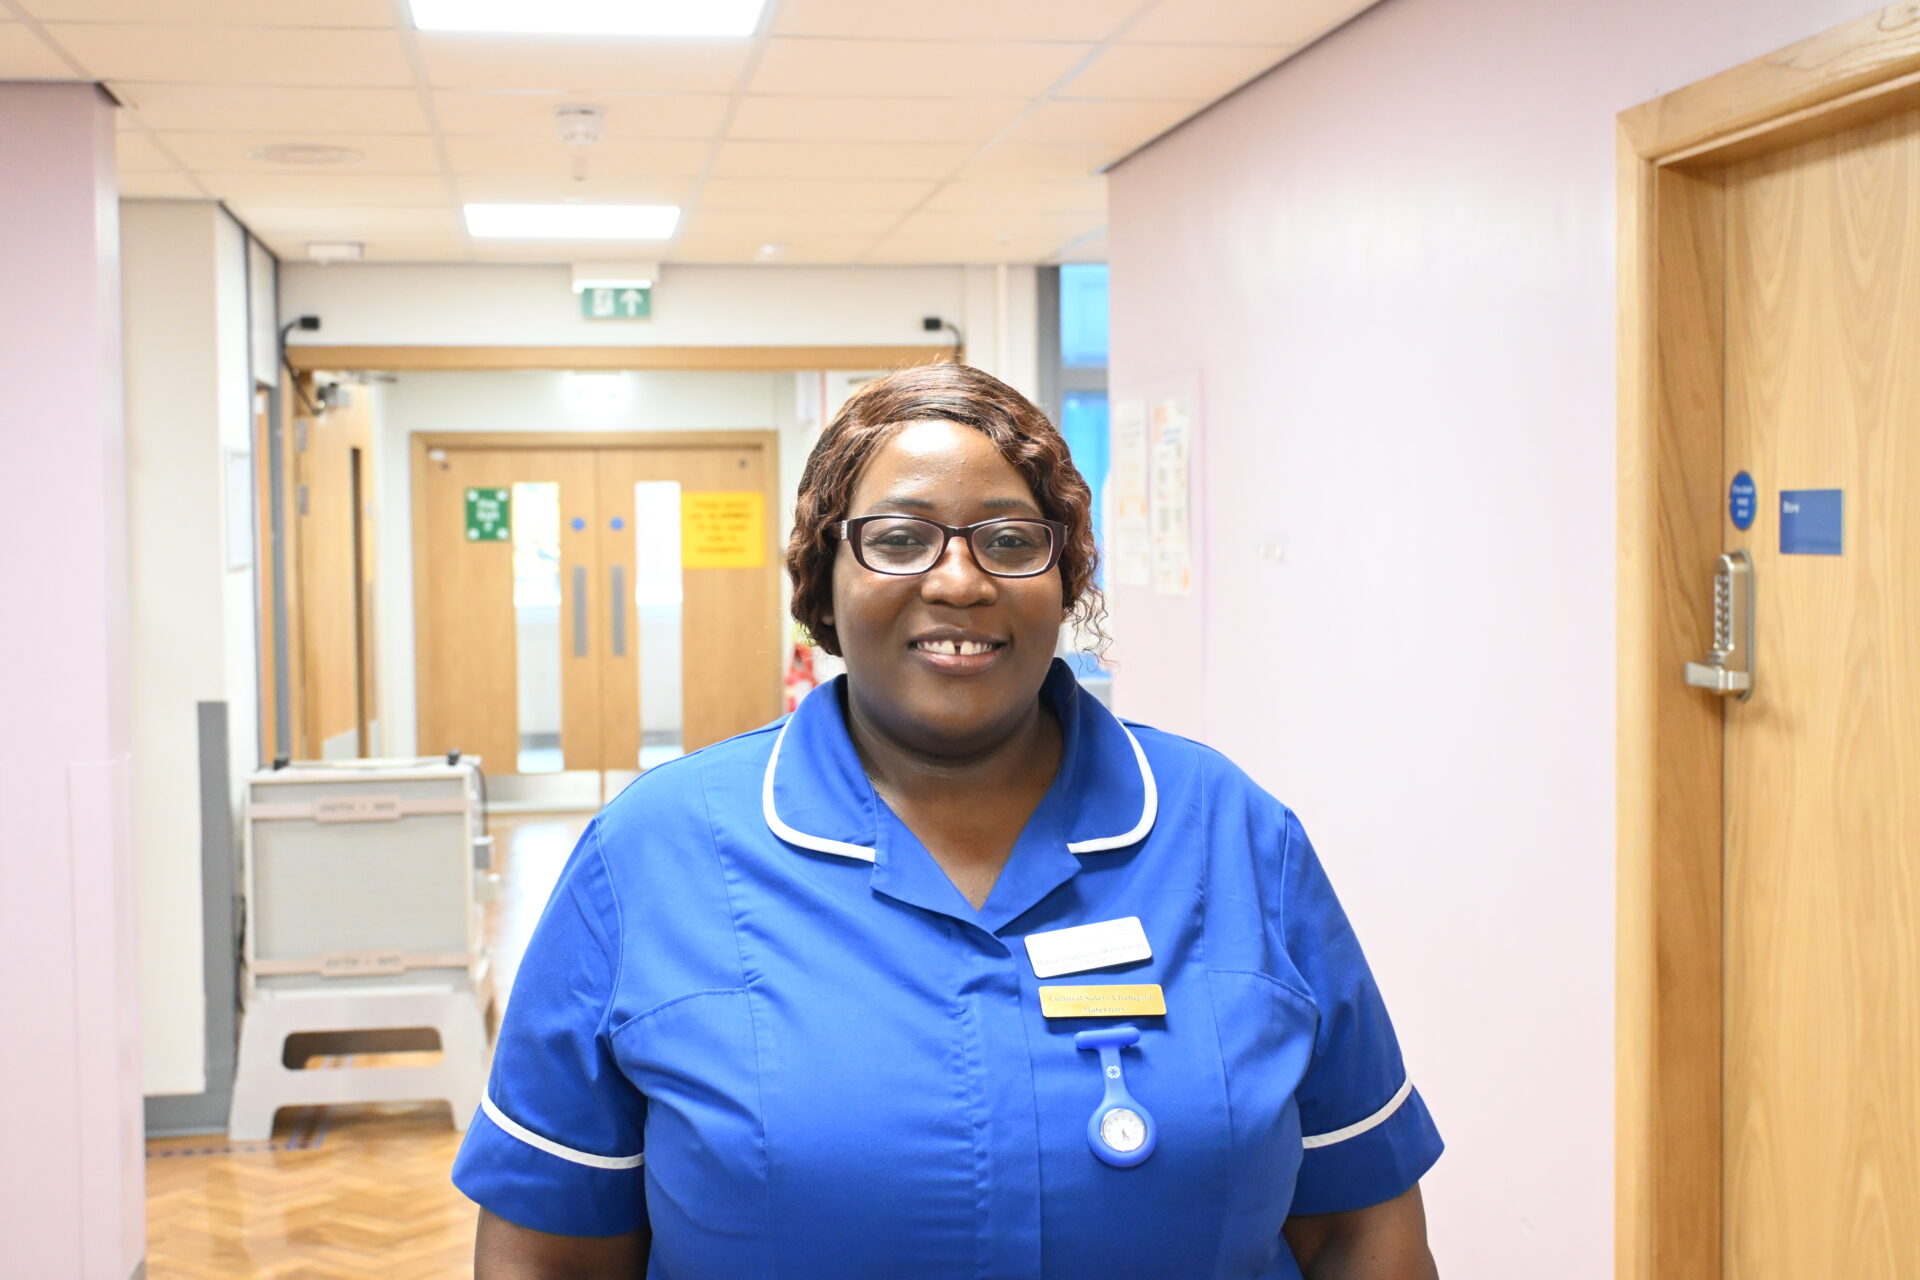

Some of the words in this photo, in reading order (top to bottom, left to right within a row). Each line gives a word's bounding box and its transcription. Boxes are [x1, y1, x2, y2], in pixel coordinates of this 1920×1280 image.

[1048, 994, 1083, 1003] Cultural
[1085, 994, 1110, 1003] Safety
[1111, 993, 1155, 1004] Champion
